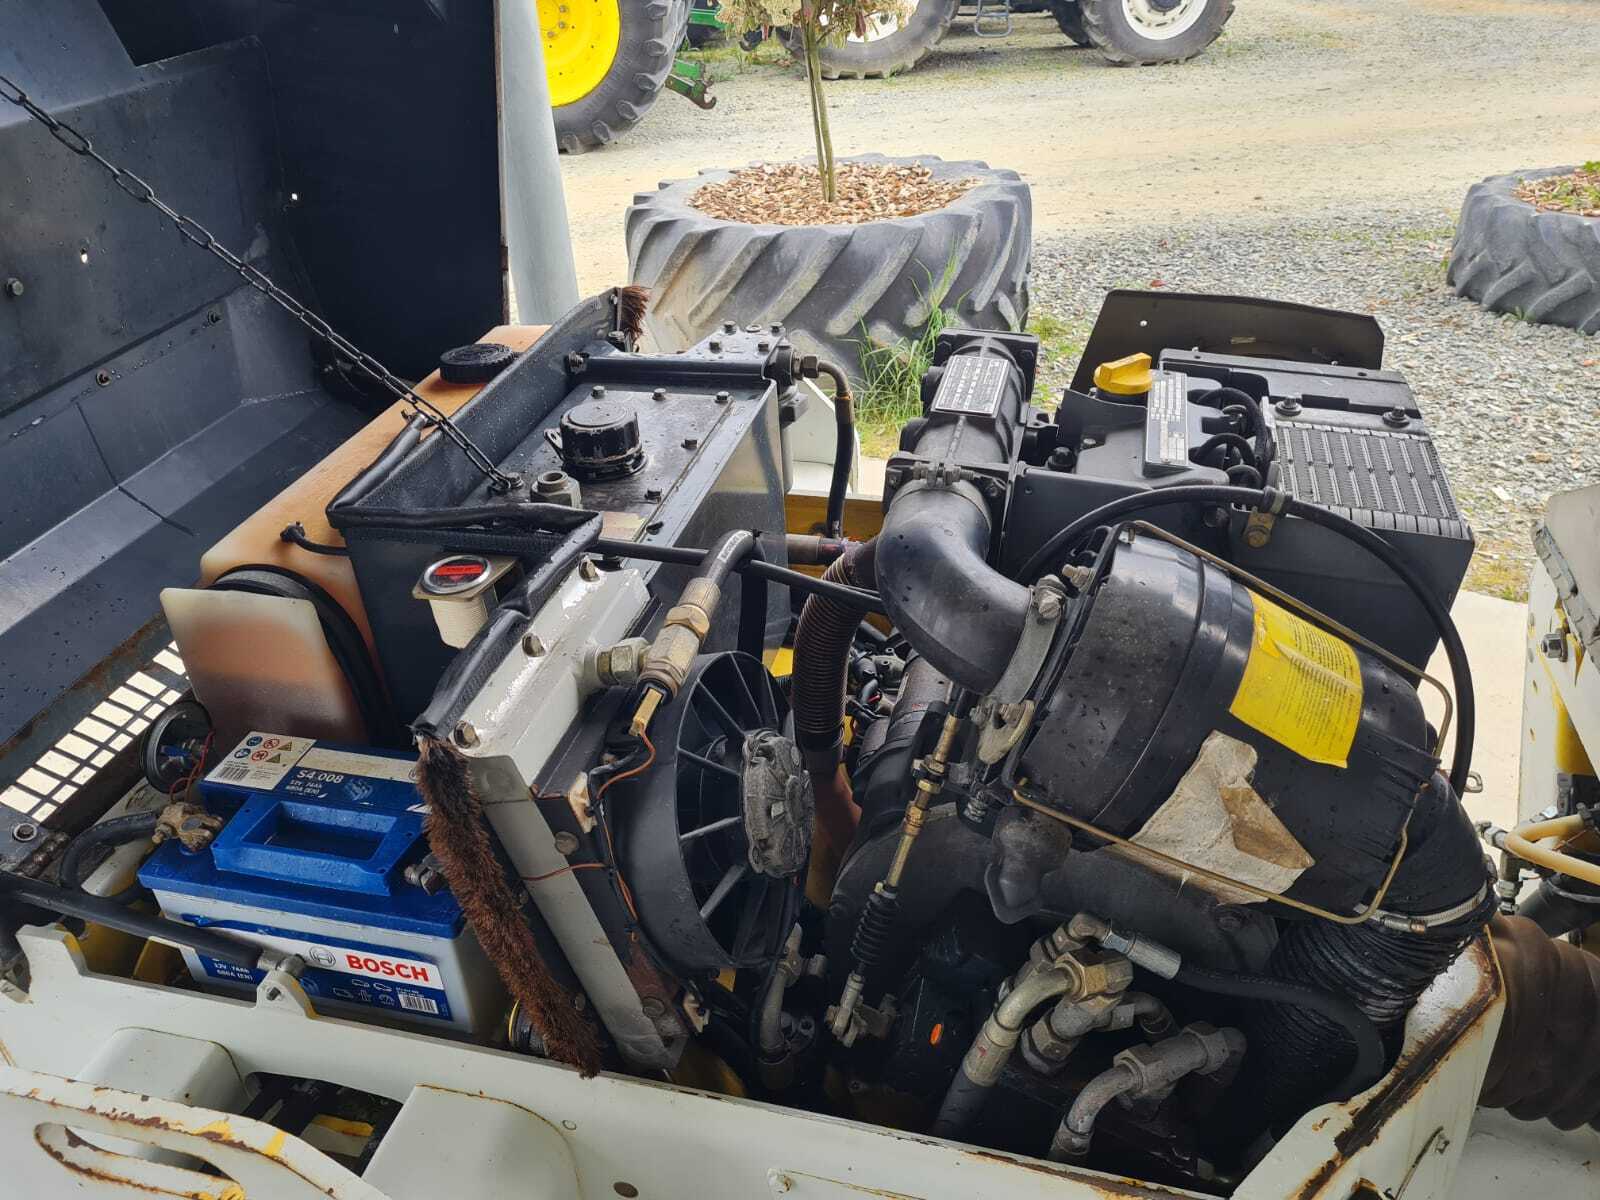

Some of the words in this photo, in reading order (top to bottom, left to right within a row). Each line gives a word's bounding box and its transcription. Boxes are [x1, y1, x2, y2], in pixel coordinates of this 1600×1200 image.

[296, 769, 316, 780] S4
[318, 773, 344, 784] 008
[345, 954, 430, 982] BOSCH
